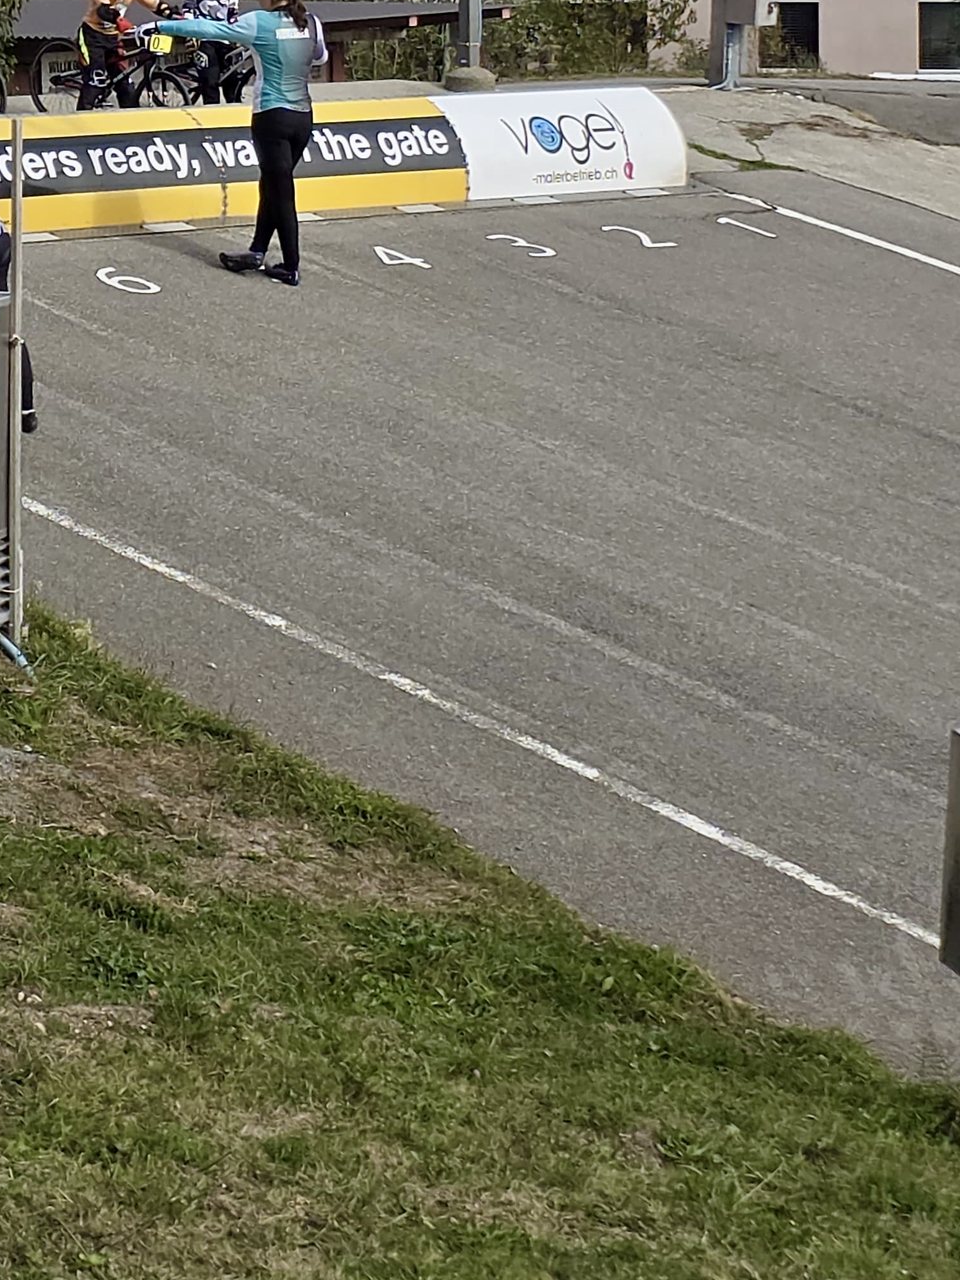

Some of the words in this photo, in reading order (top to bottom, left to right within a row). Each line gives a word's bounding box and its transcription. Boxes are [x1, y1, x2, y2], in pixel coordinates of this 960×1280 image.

[87, 136, 202, 179] ready,
[311, 127, 372, 162] the
[377, 122, 450, 166] gate
[485, 234, 558, 257] 3
[601, 225, 679, 248] 2
[373, 245, 433, 270] 4
[95, 266, 162, 295] 6
